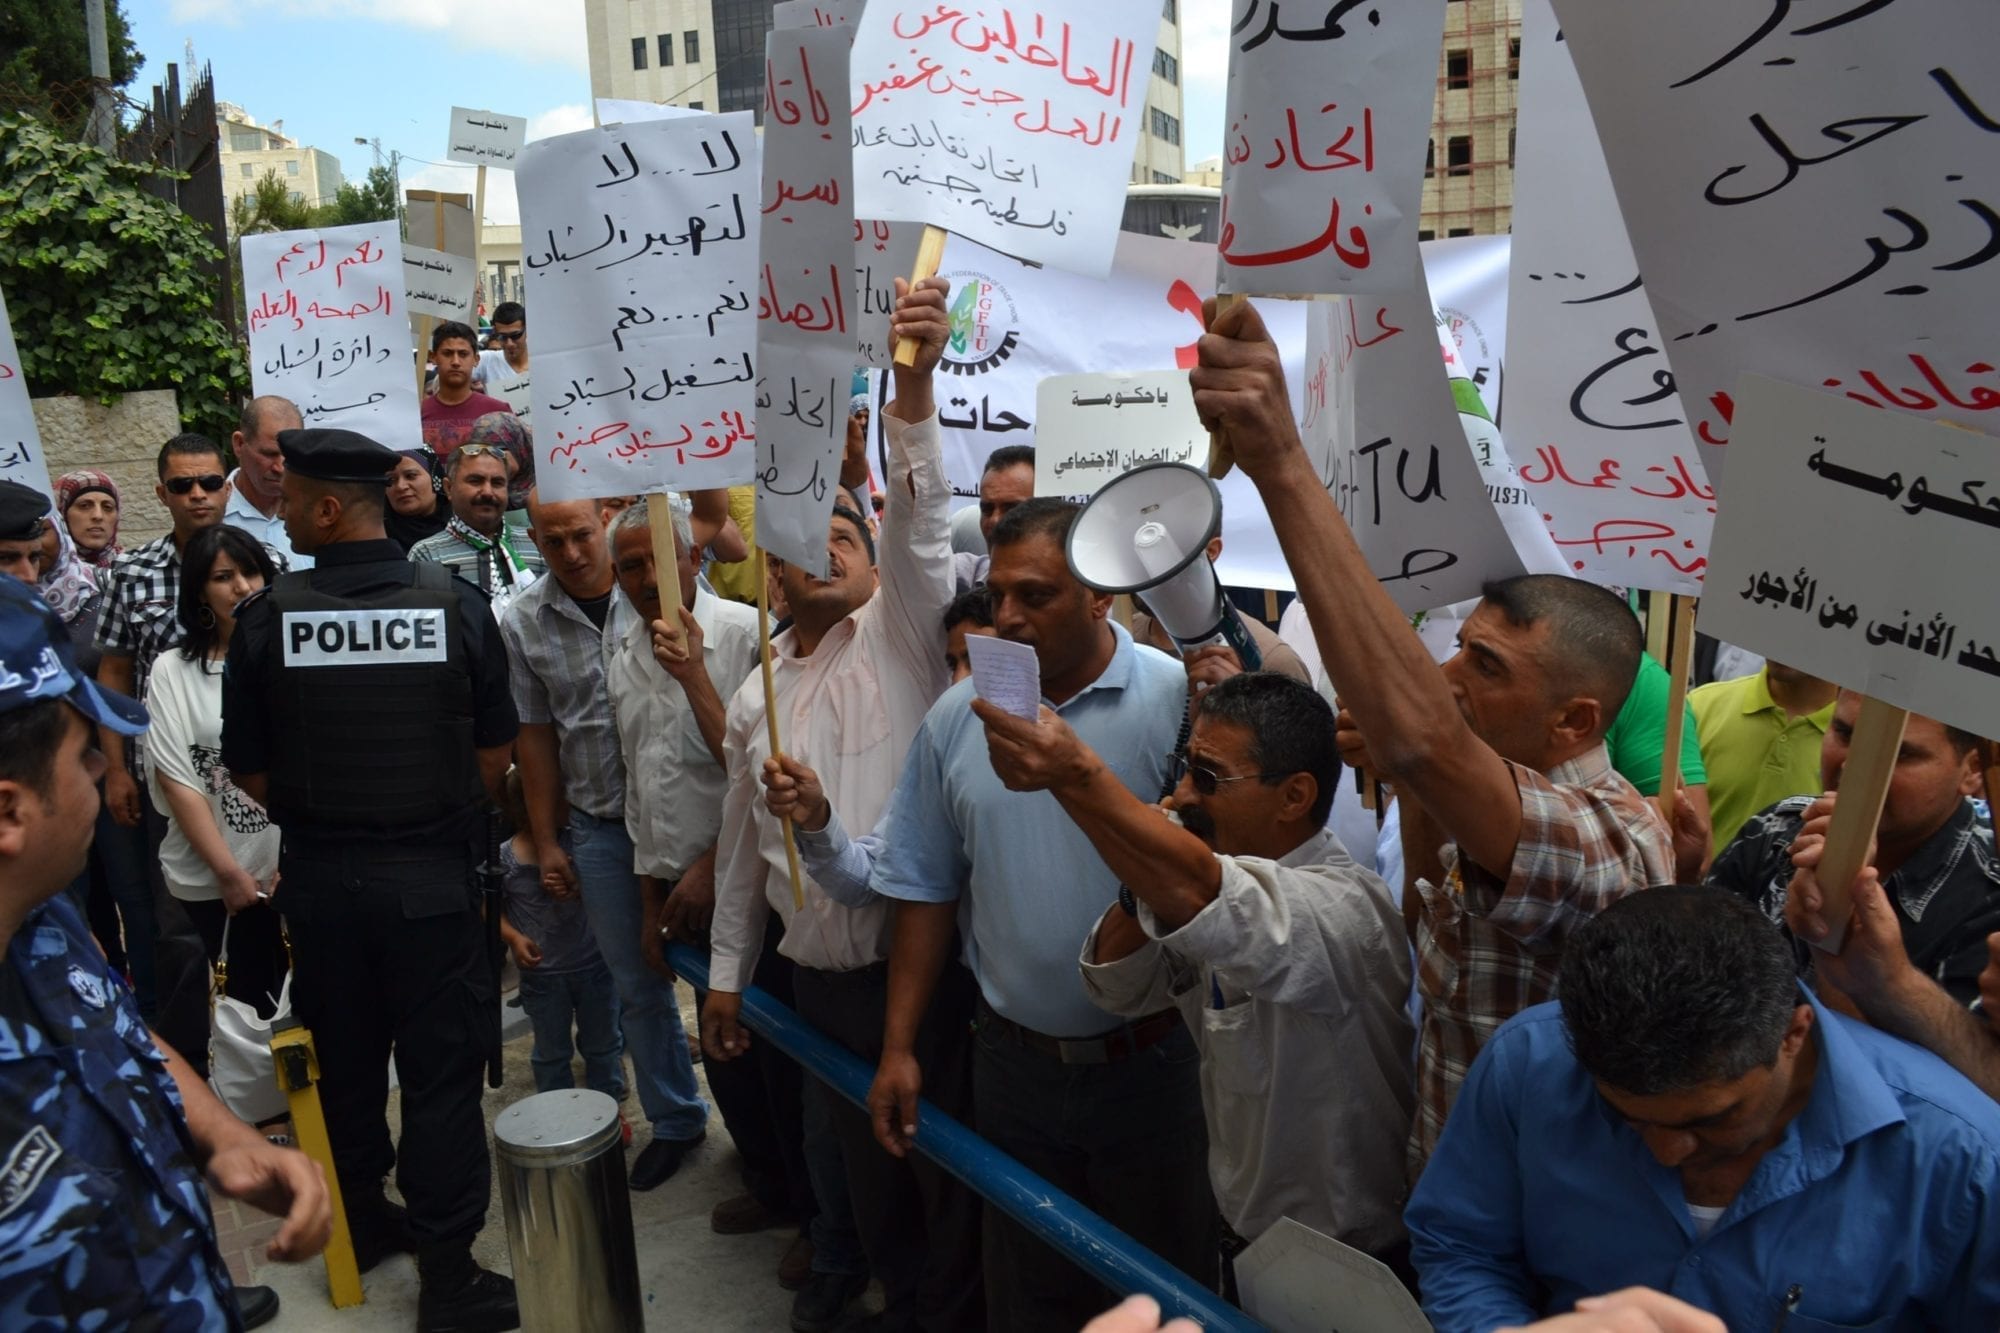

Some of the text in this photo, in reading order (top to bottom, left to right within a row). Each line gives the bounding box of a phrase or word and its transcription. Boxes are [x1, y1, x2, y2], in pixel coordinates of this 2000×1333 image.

[1218, 194, 1372, 270] فلسط
[975, 282, 993, 352] PGFTU
[1739, 566, 1818, 613] الأجور
[1818, 596, 1859, 630] من
[290, 617, 438, 655] POLICE
[1865, 610, 1956, 661] الأدنى
[0, 645, 60, 695] الشرط
